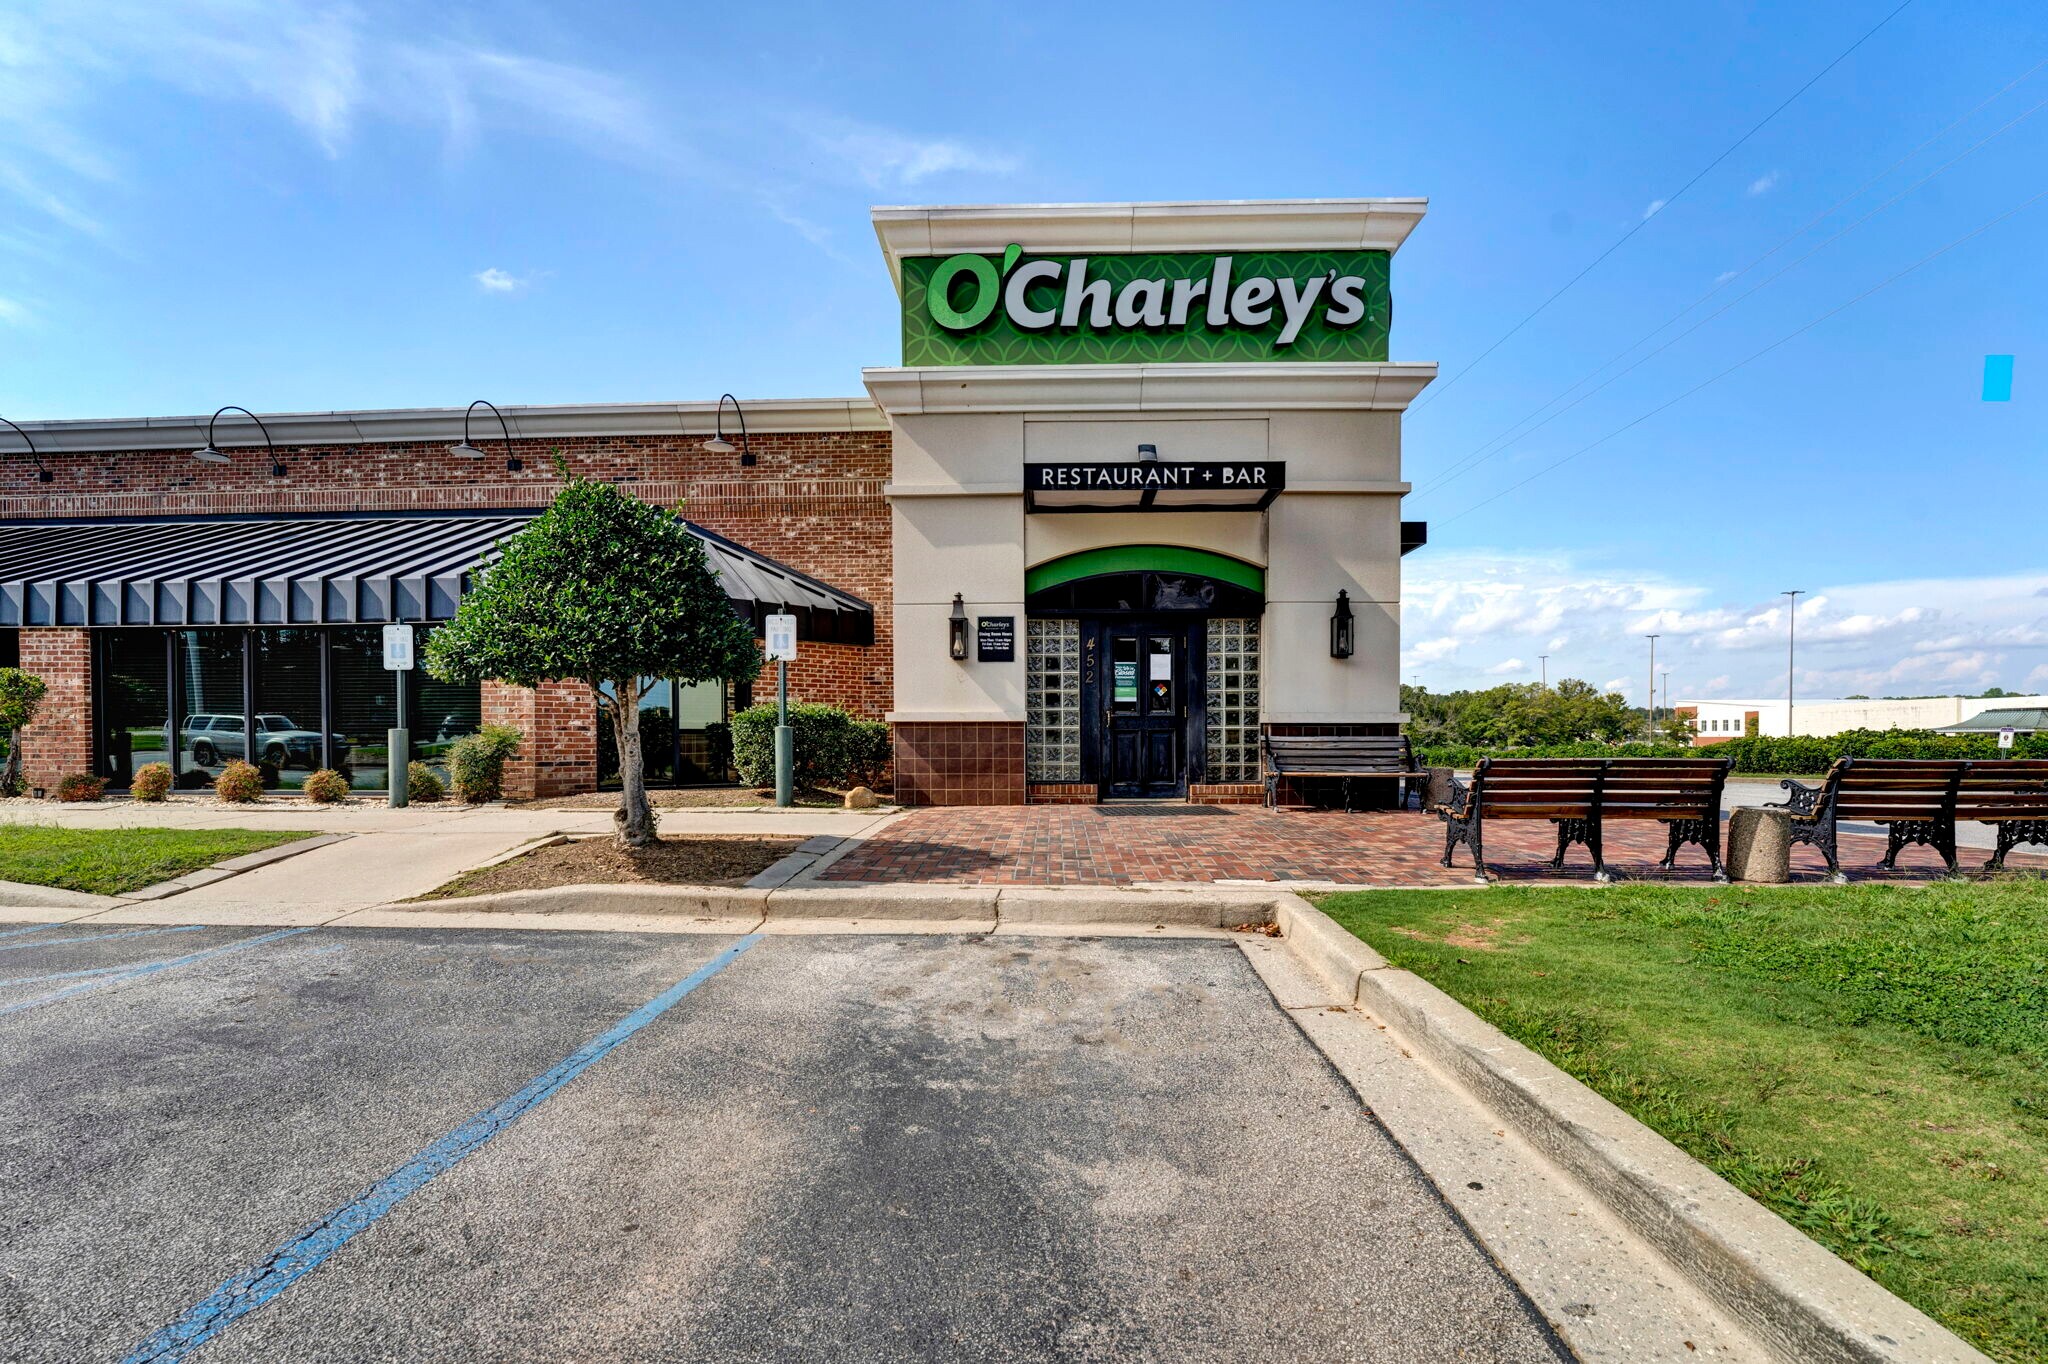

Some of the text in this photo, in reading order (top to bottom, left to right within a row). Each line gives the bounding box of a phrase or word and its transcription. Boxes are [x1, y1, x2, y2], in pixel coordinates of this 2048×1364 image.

[927, 243, 1366, 344] O'Charley's
[1042, 466, 1195, 485] RESTAURANT
[1222, 466, 1267, 484] BAR
